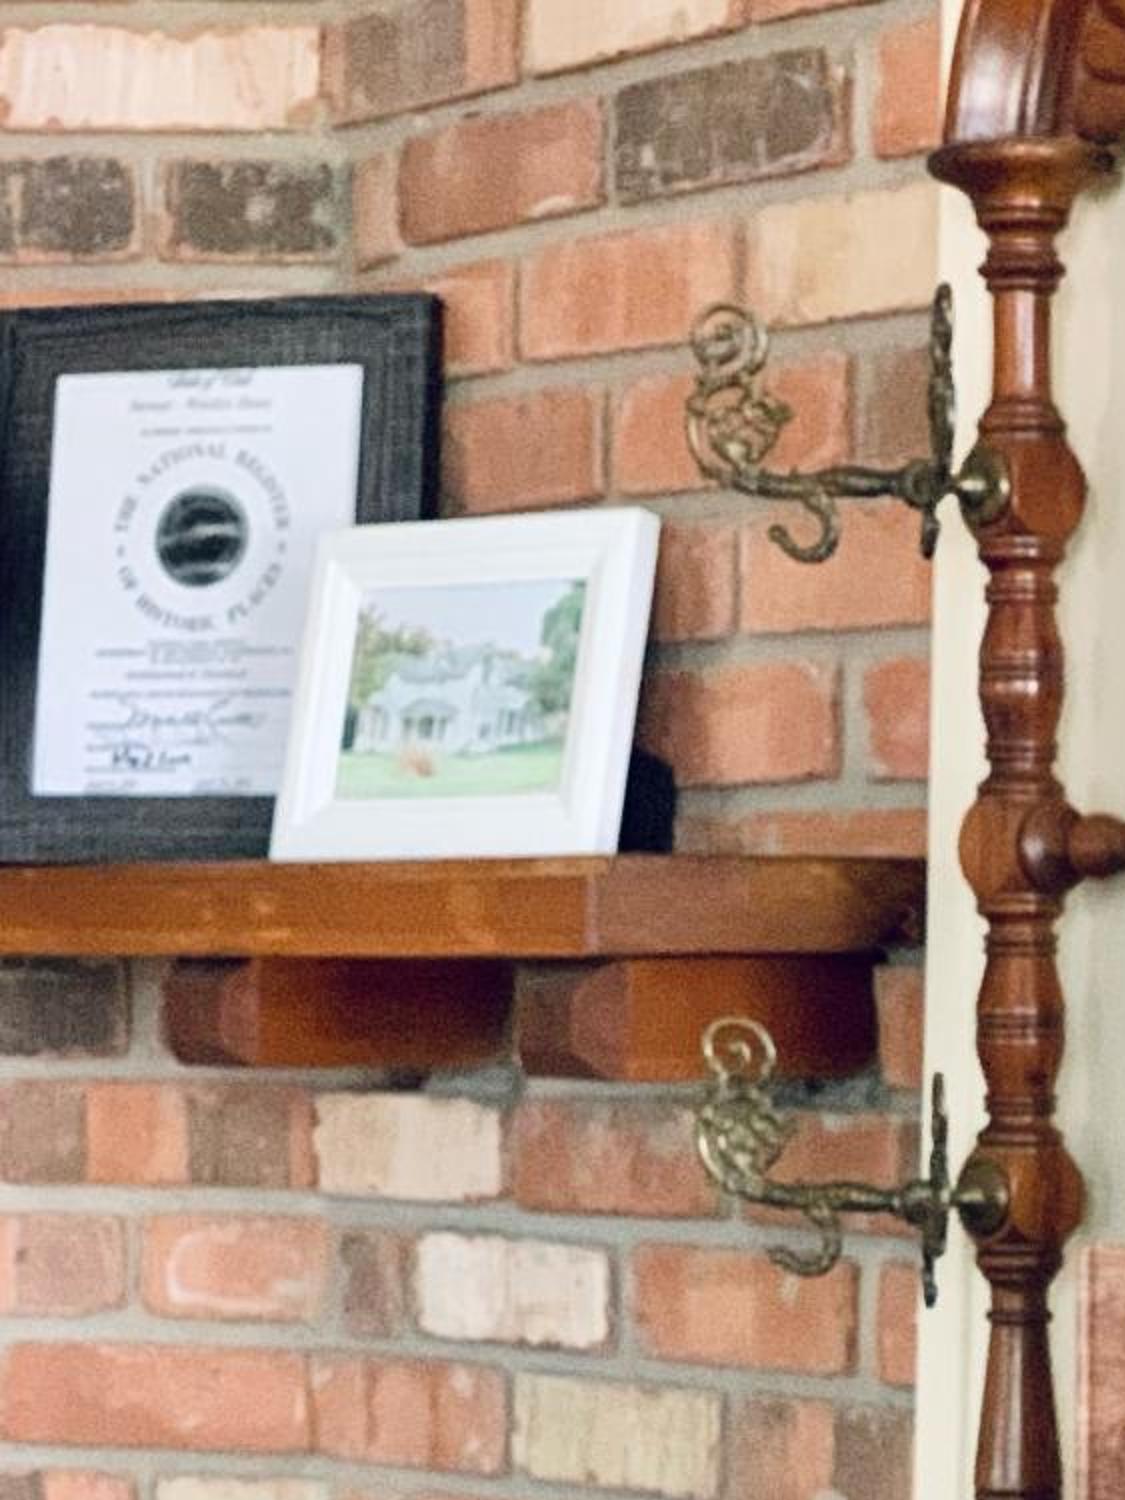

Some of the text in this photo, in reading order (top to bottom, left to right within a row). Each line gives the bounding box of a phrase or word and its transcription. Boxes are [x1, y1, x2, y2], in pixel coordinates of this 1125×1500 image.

[115, 443, 290, 531] THE NATIONAL REGISTER
[135, 592, 213, 630] HISTORIC
[227, 564, 283, 625] PLACES
